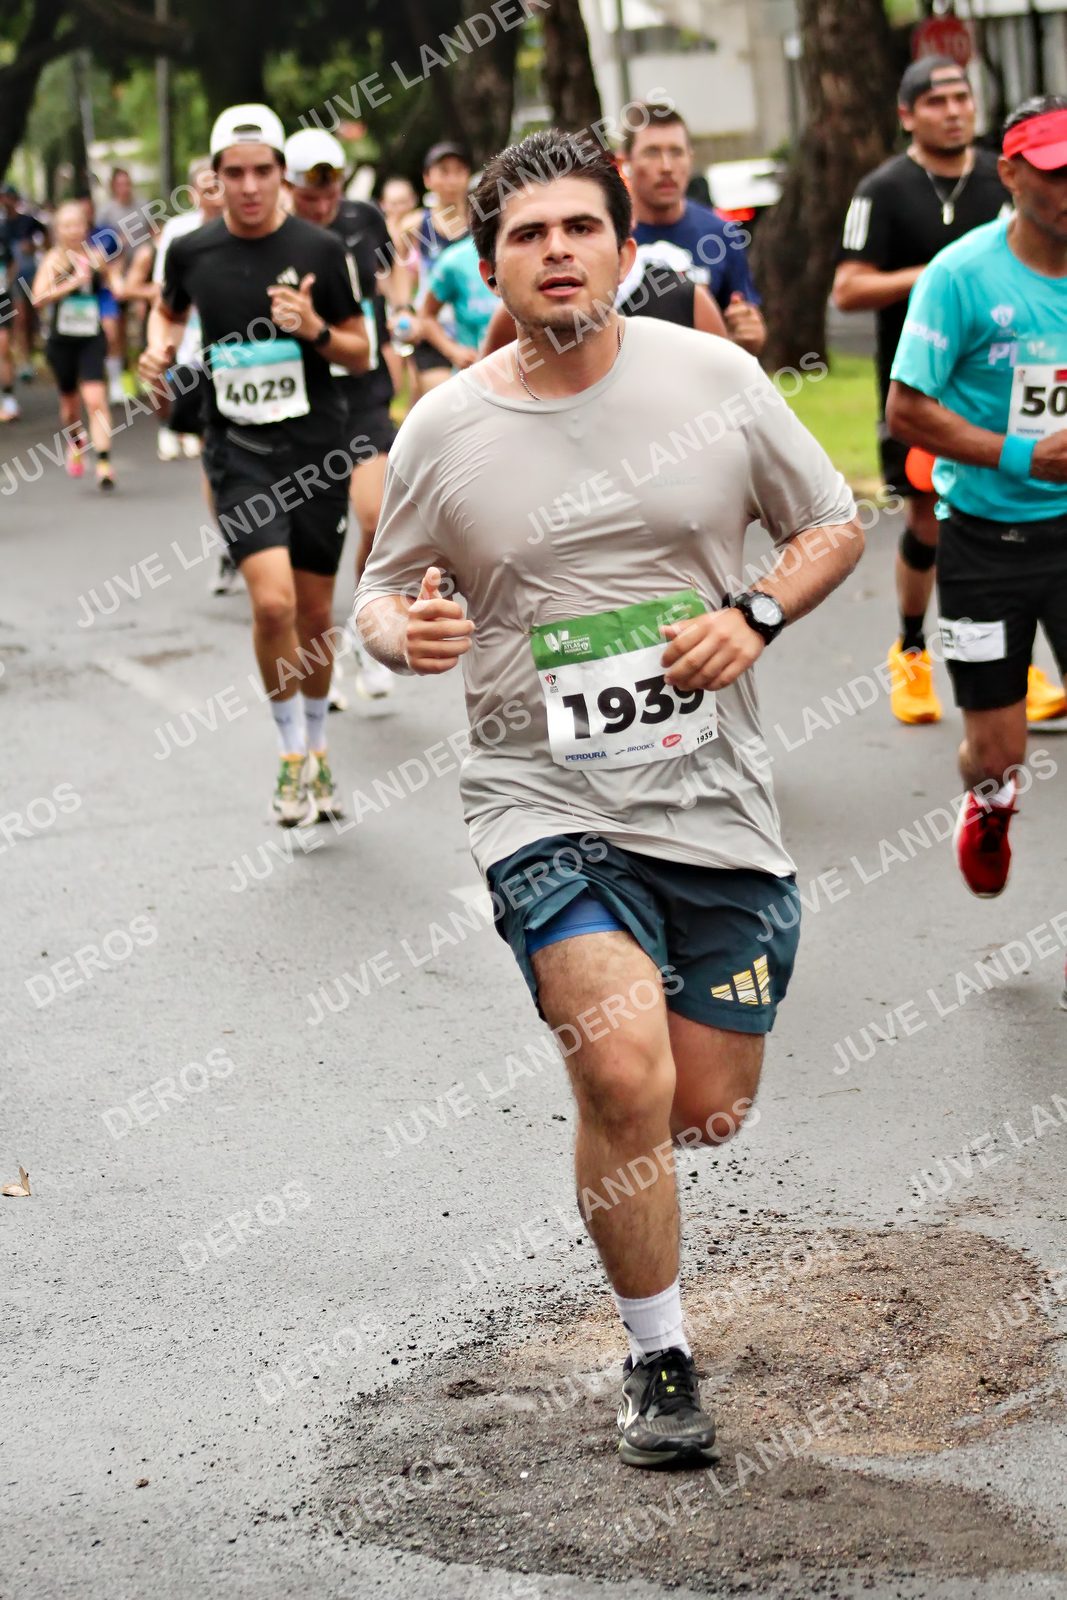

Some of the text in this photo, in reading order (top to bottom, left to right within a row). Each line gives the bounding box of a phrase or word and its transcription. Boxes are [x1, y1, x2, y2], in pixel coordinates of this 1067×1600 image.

[225, 377, 296, 406] 4029
[562, 674, 704, 740] 1939
[696, 730, 713, 744] 1939
[626, 742, 655, 753] BROOKS
[565, 750, 608, 762] PERDURA
